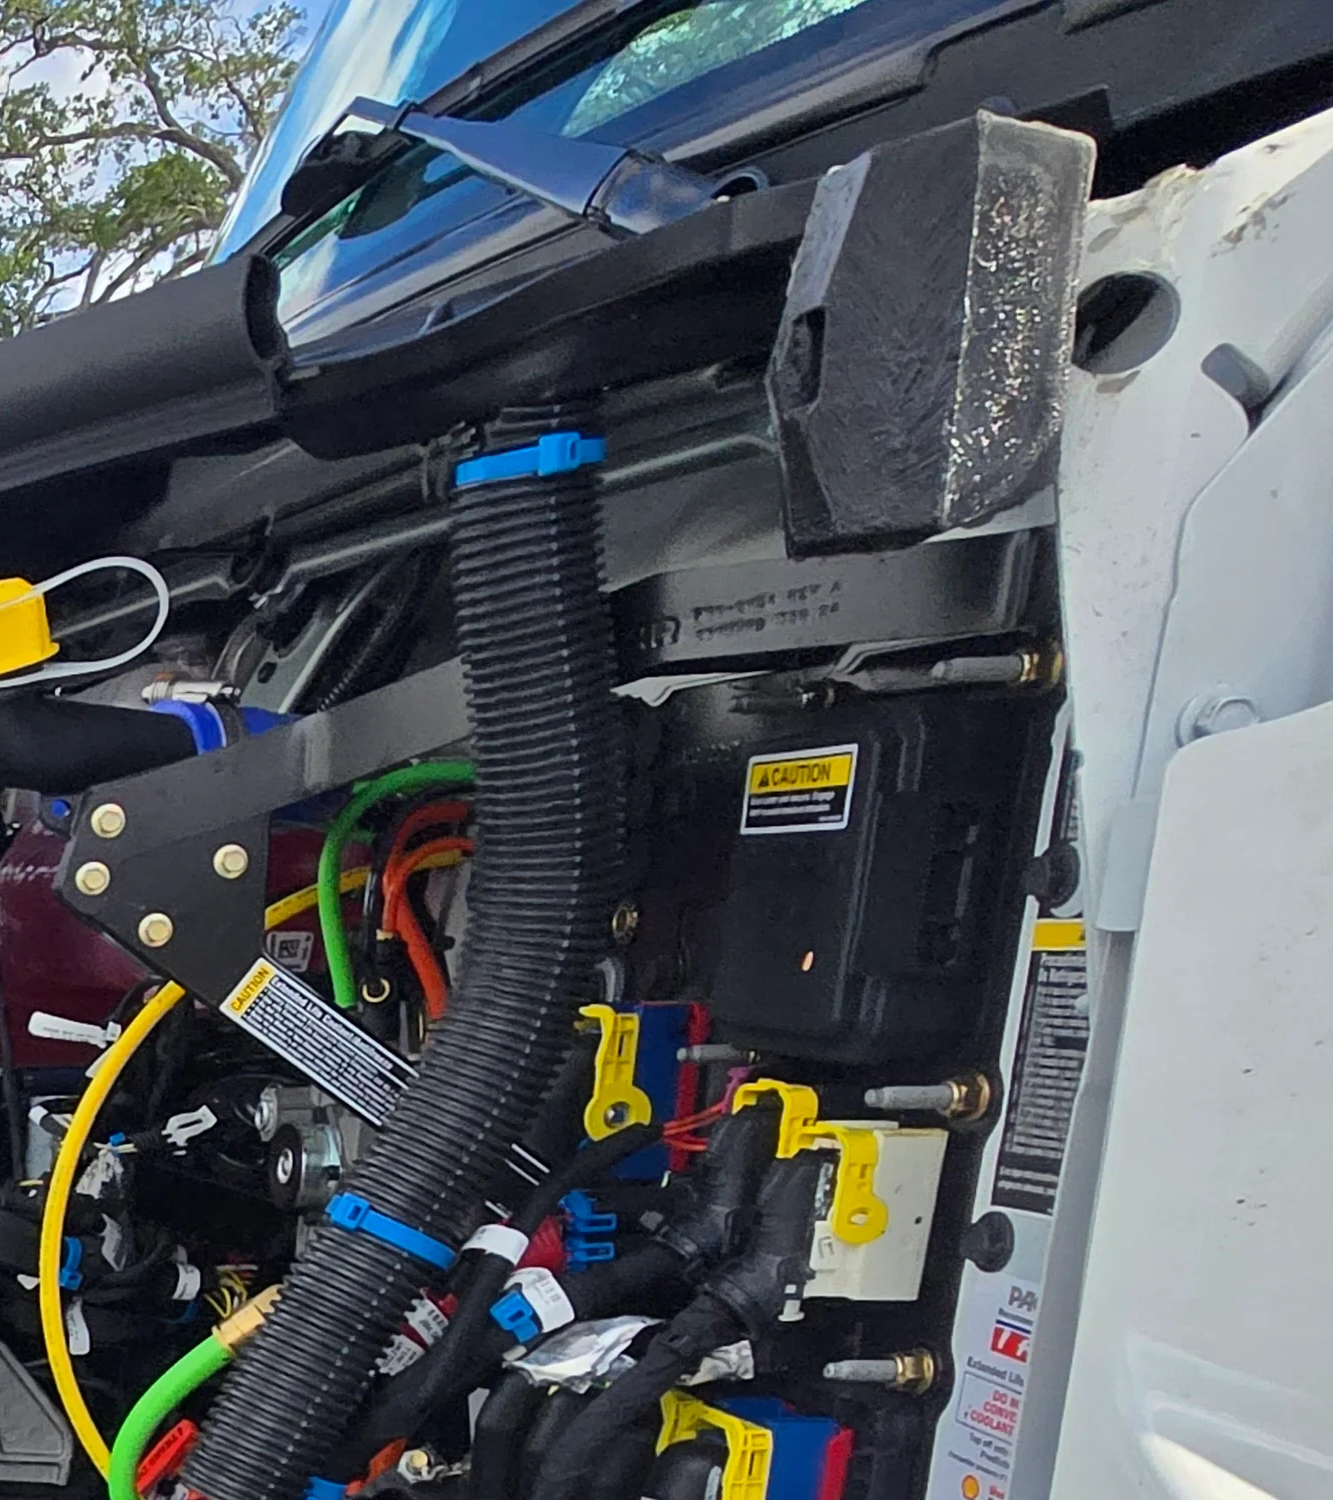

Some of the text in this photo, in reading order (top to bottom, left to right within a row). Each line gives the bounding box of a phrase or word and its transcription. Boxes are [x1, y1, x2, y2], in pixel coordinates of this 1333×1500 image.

[772, 763, 832, 786] CAUTION
[231, 968, 269, 1012] CAUTION
[1008, 1285, 1038, 1312] PA
[984, 1401, 1017, 1424] CONVE
